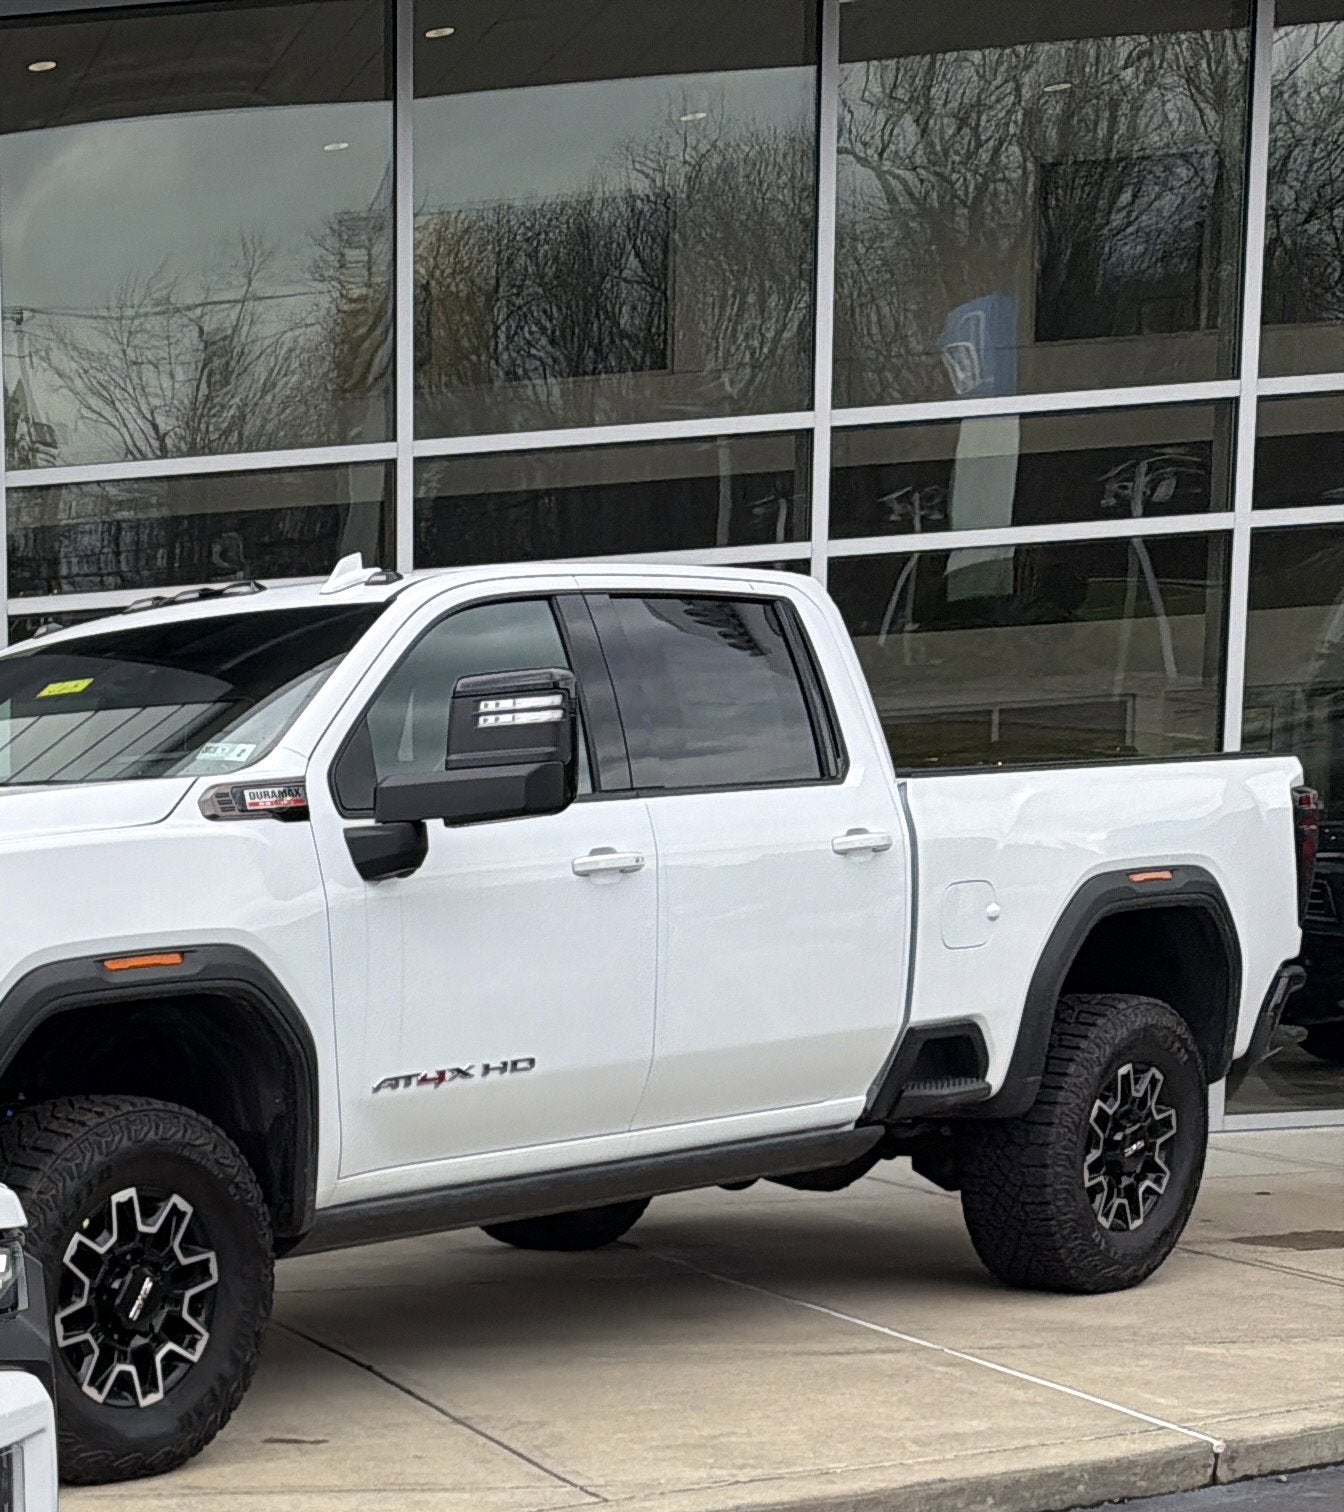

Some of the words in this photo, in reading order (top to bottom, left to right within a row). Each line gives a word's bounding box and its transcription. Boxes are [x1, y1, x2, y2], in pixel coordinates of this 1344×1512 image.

[248, 787, 302, 801] DURAMAX
[371, 1063, 475, 1095] AT4X
[481, 1056, 536, 1078] HD
